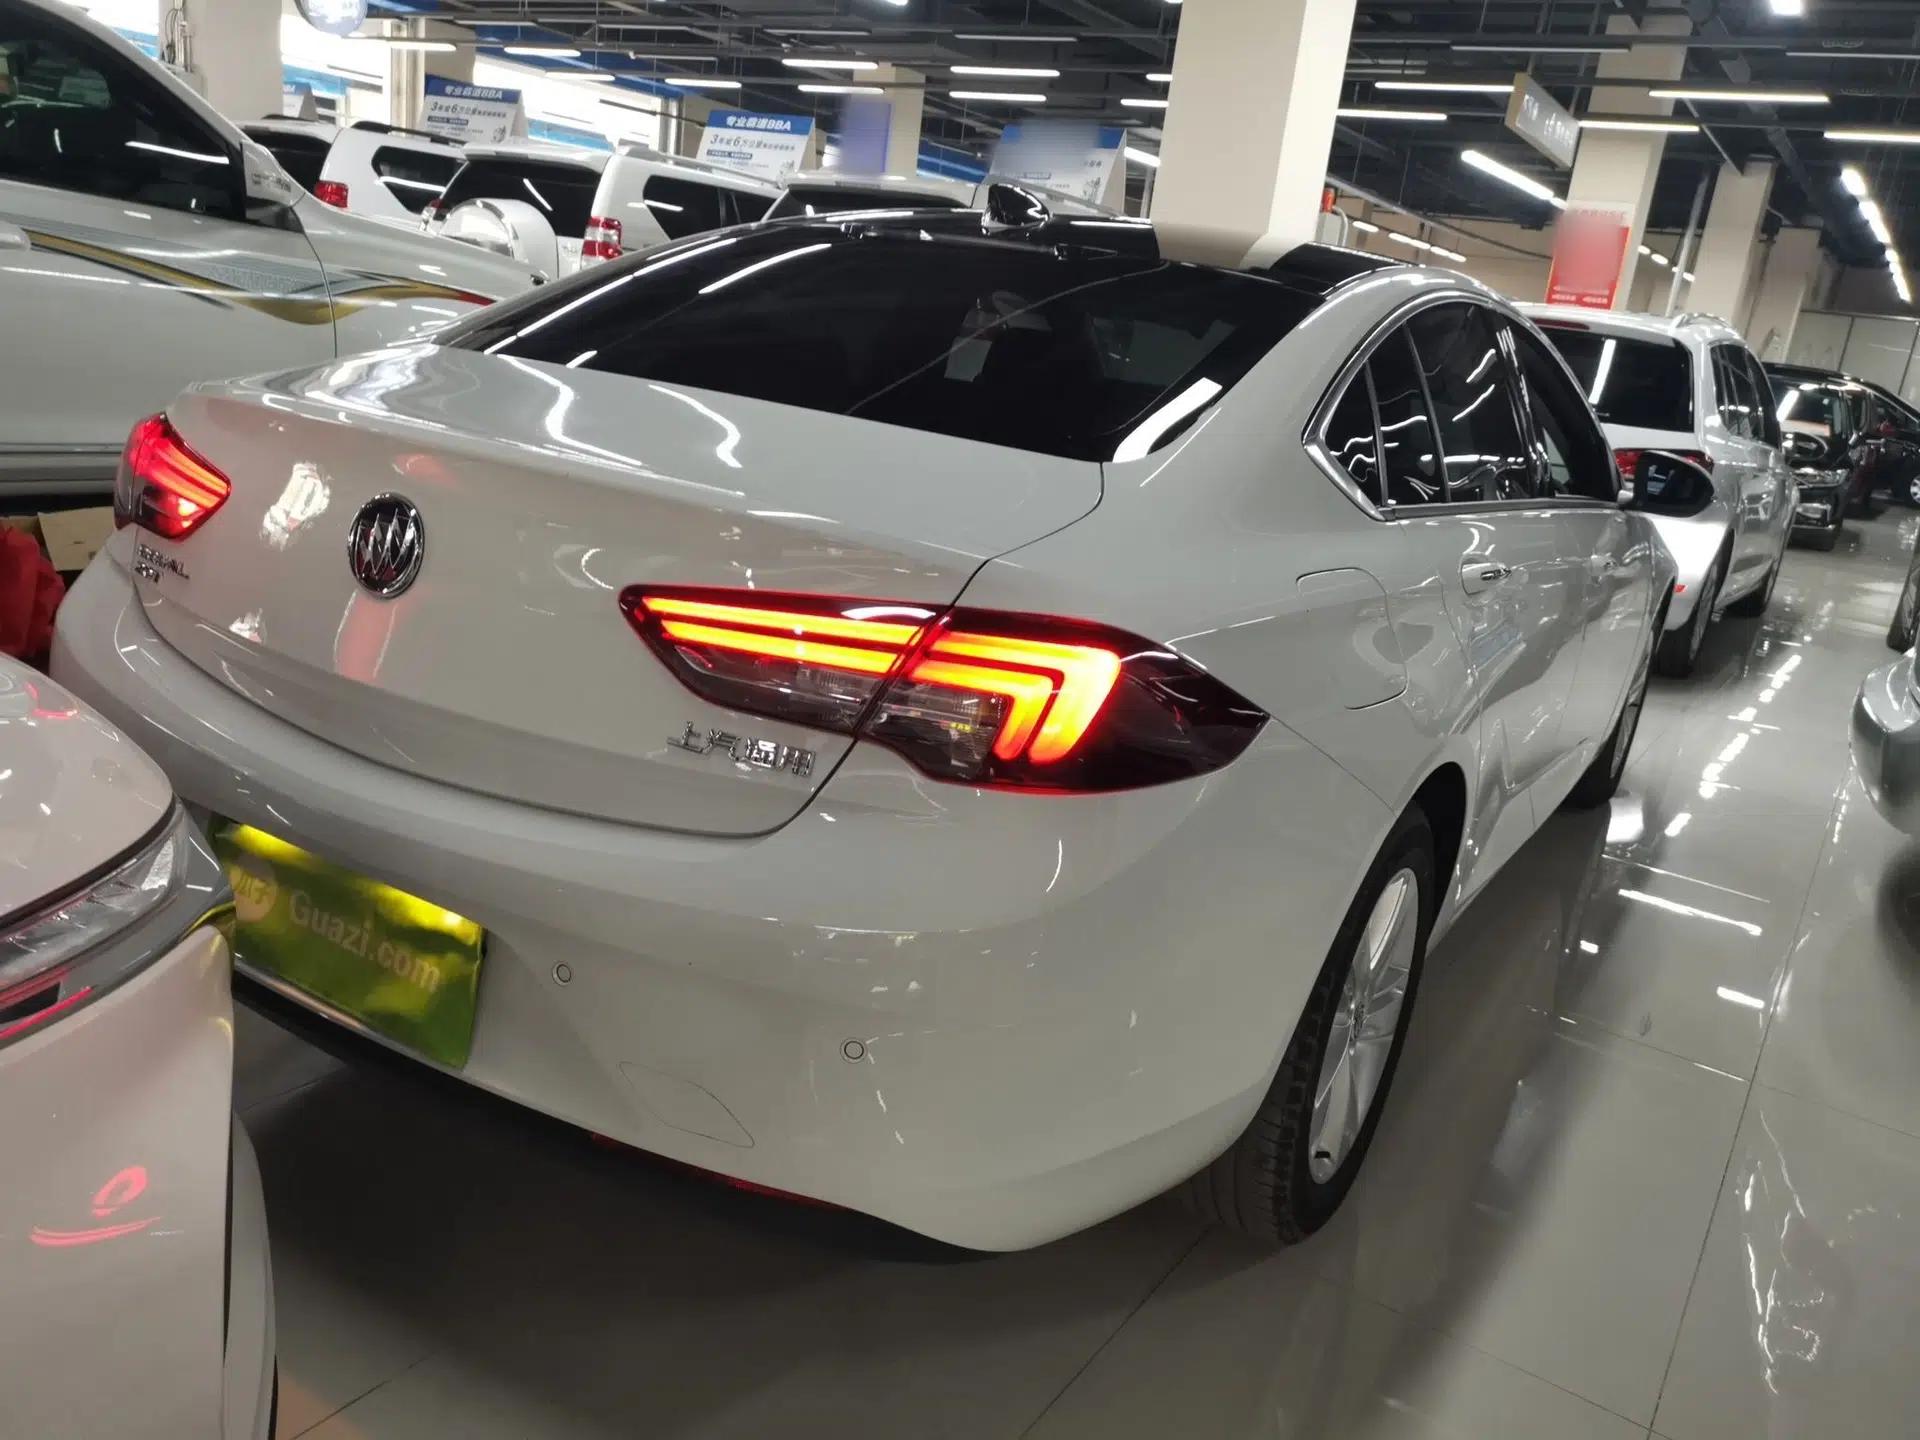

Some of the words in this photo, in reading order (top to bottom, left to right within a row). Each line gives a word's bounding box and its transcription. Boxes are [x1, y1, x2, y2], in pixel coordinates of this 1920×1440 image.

[667, 721, 816, 777] 上汽通用
[289, 889, 441, 994] Guazi.com
